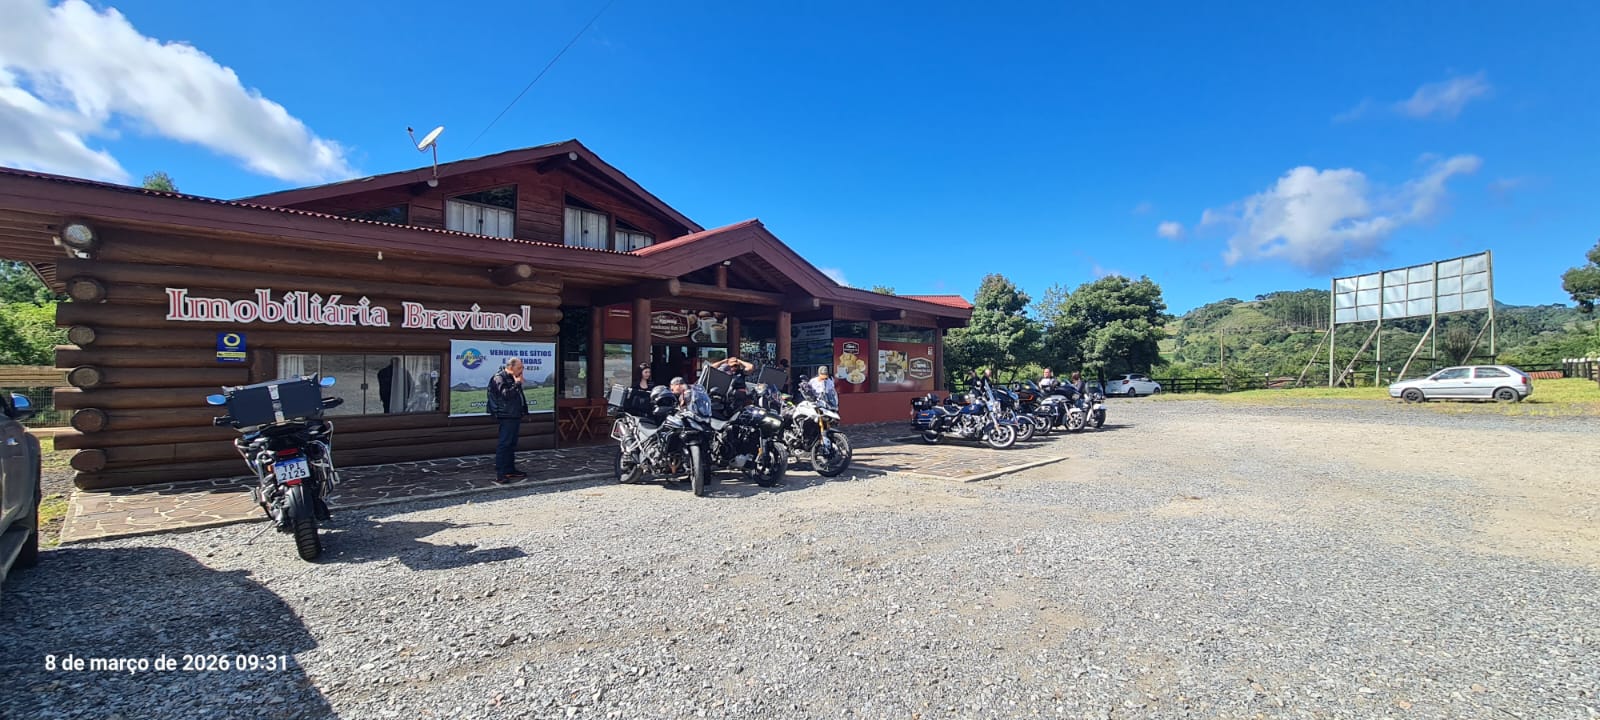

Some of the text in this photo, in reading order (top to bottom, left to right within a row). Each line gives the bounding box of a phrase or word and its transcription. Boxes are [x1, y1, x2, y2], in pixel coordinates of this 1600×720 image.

[165, 287, 532, 332] Imobiliária Bravimol
[490, 349, 518, 357] VENDAS
[530, 349, 552, 357] SÍTIOS
